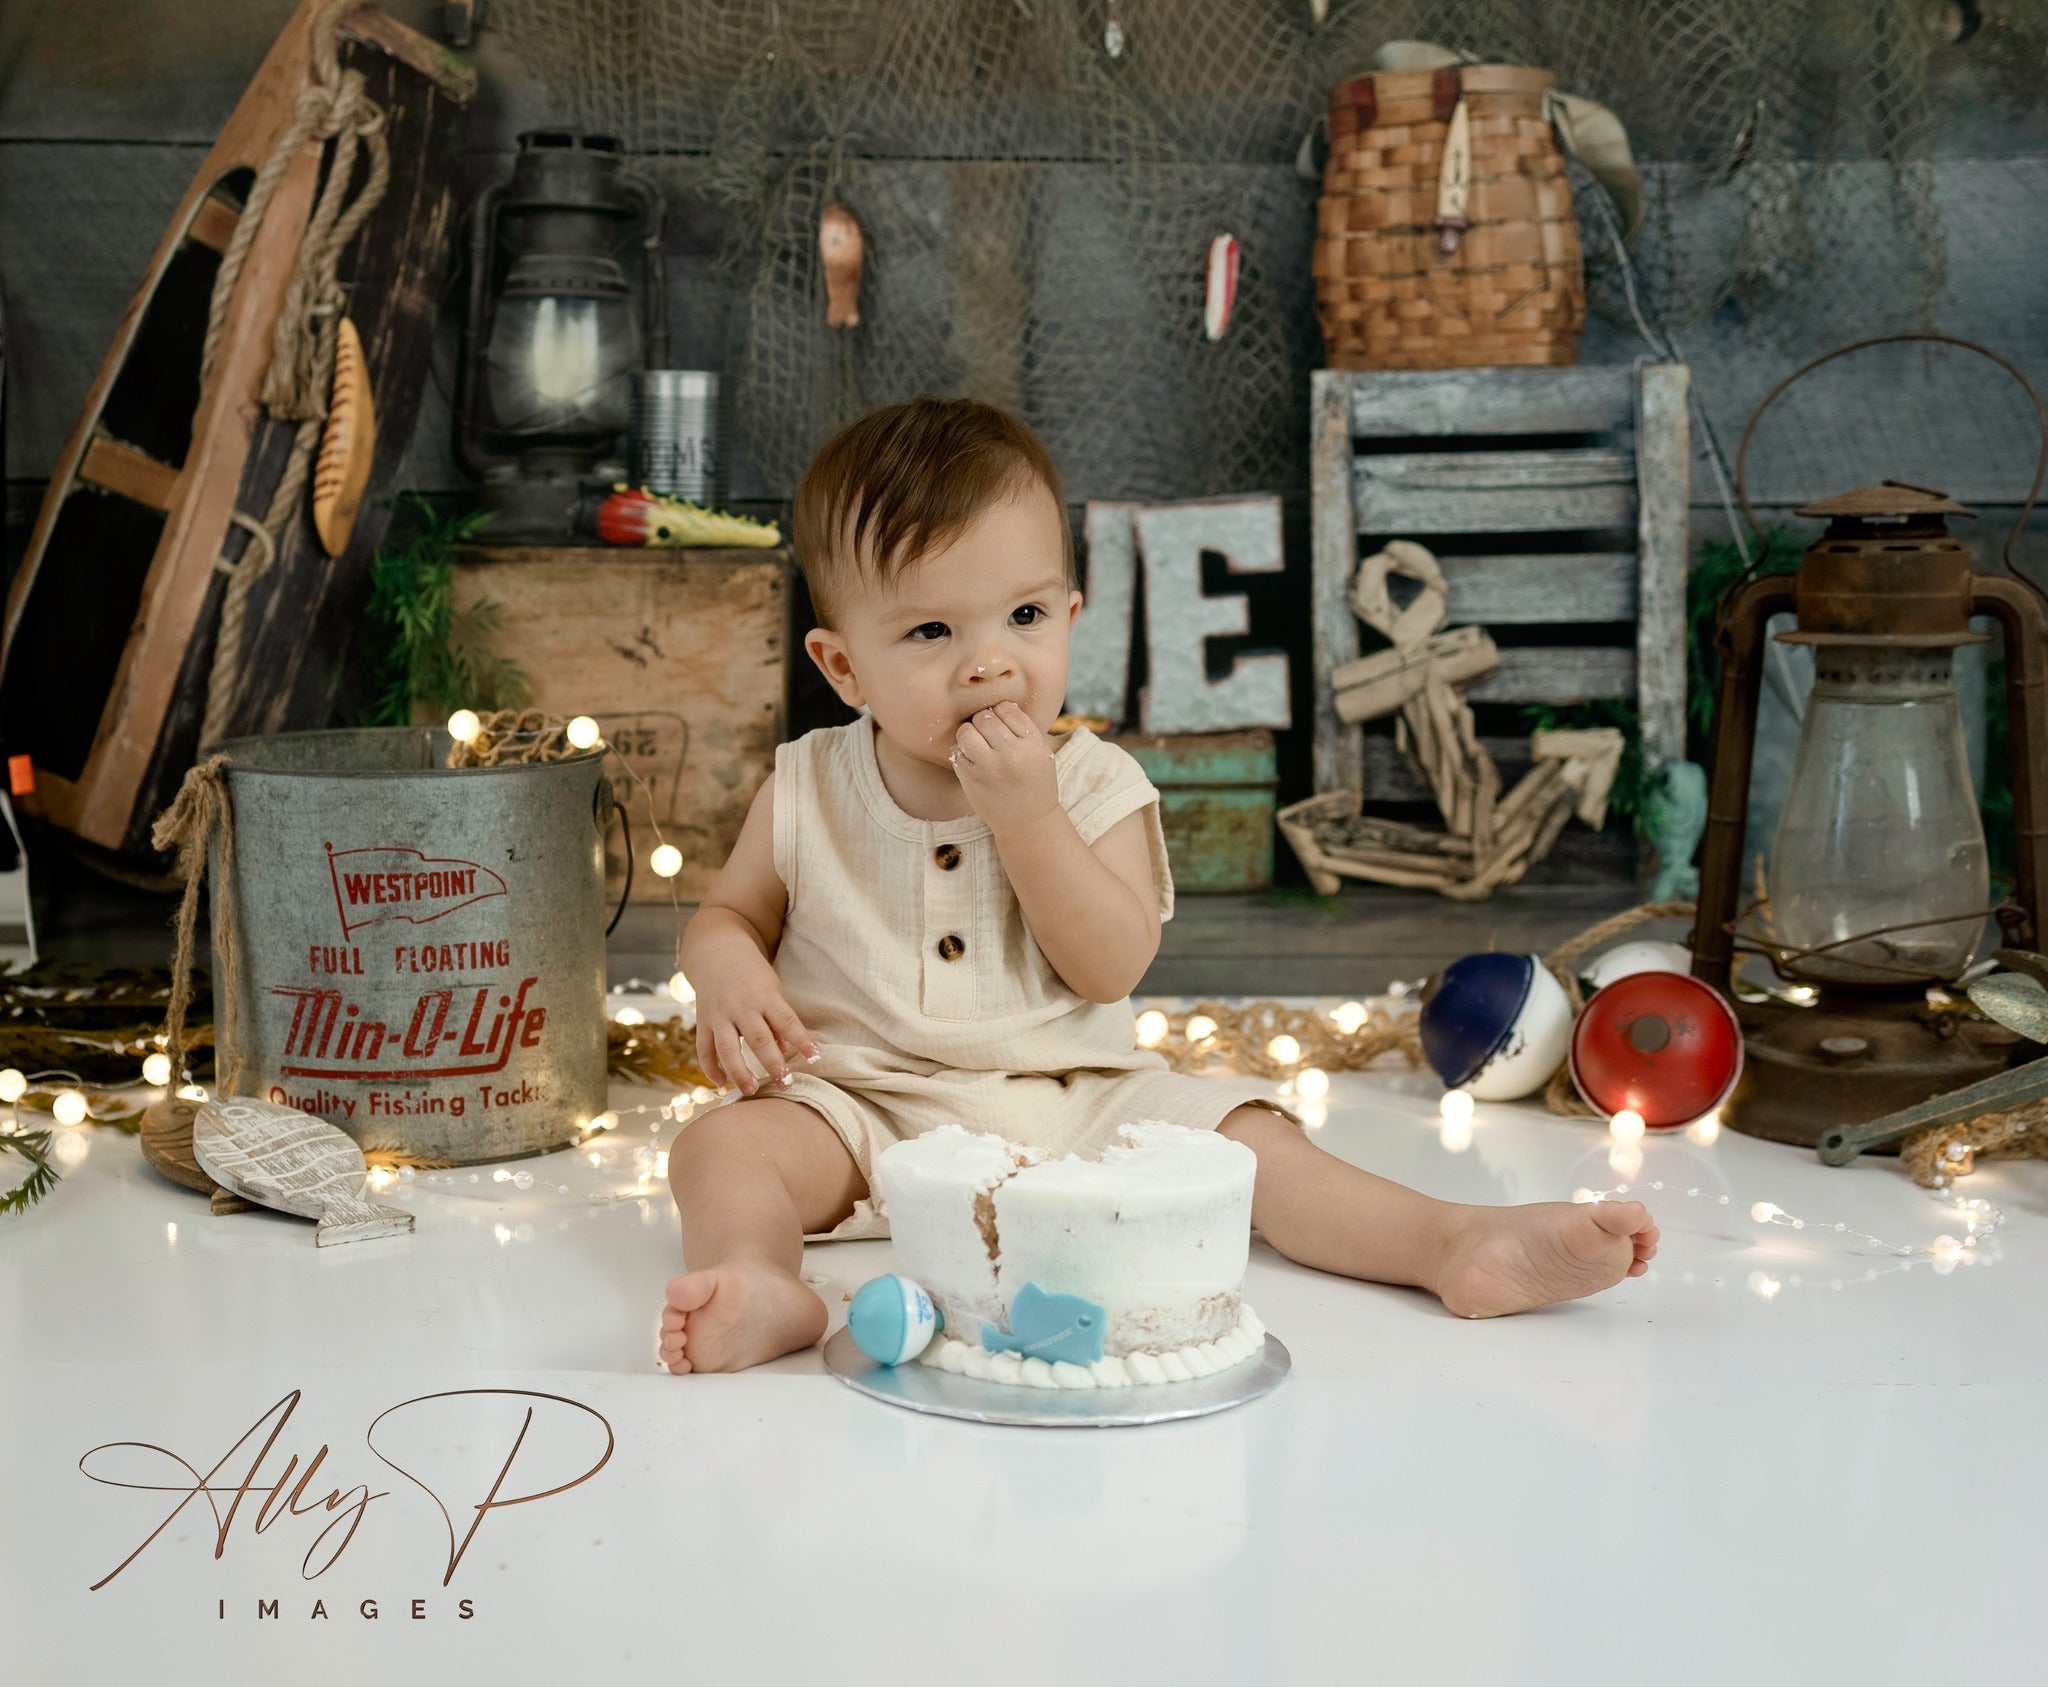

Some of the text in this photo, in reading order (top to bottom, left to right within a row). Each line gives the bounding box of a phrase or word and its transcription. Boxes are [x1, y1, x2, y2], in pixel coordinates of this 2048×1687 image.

[343, 868, 477, 906] WESTPOINT
[309, 939, 510, 975] FULL FLOATING
[271, 977, 547, 1066] Min-O-Life
[269, 1079, 548, 1120] Quality Fishing Tack
